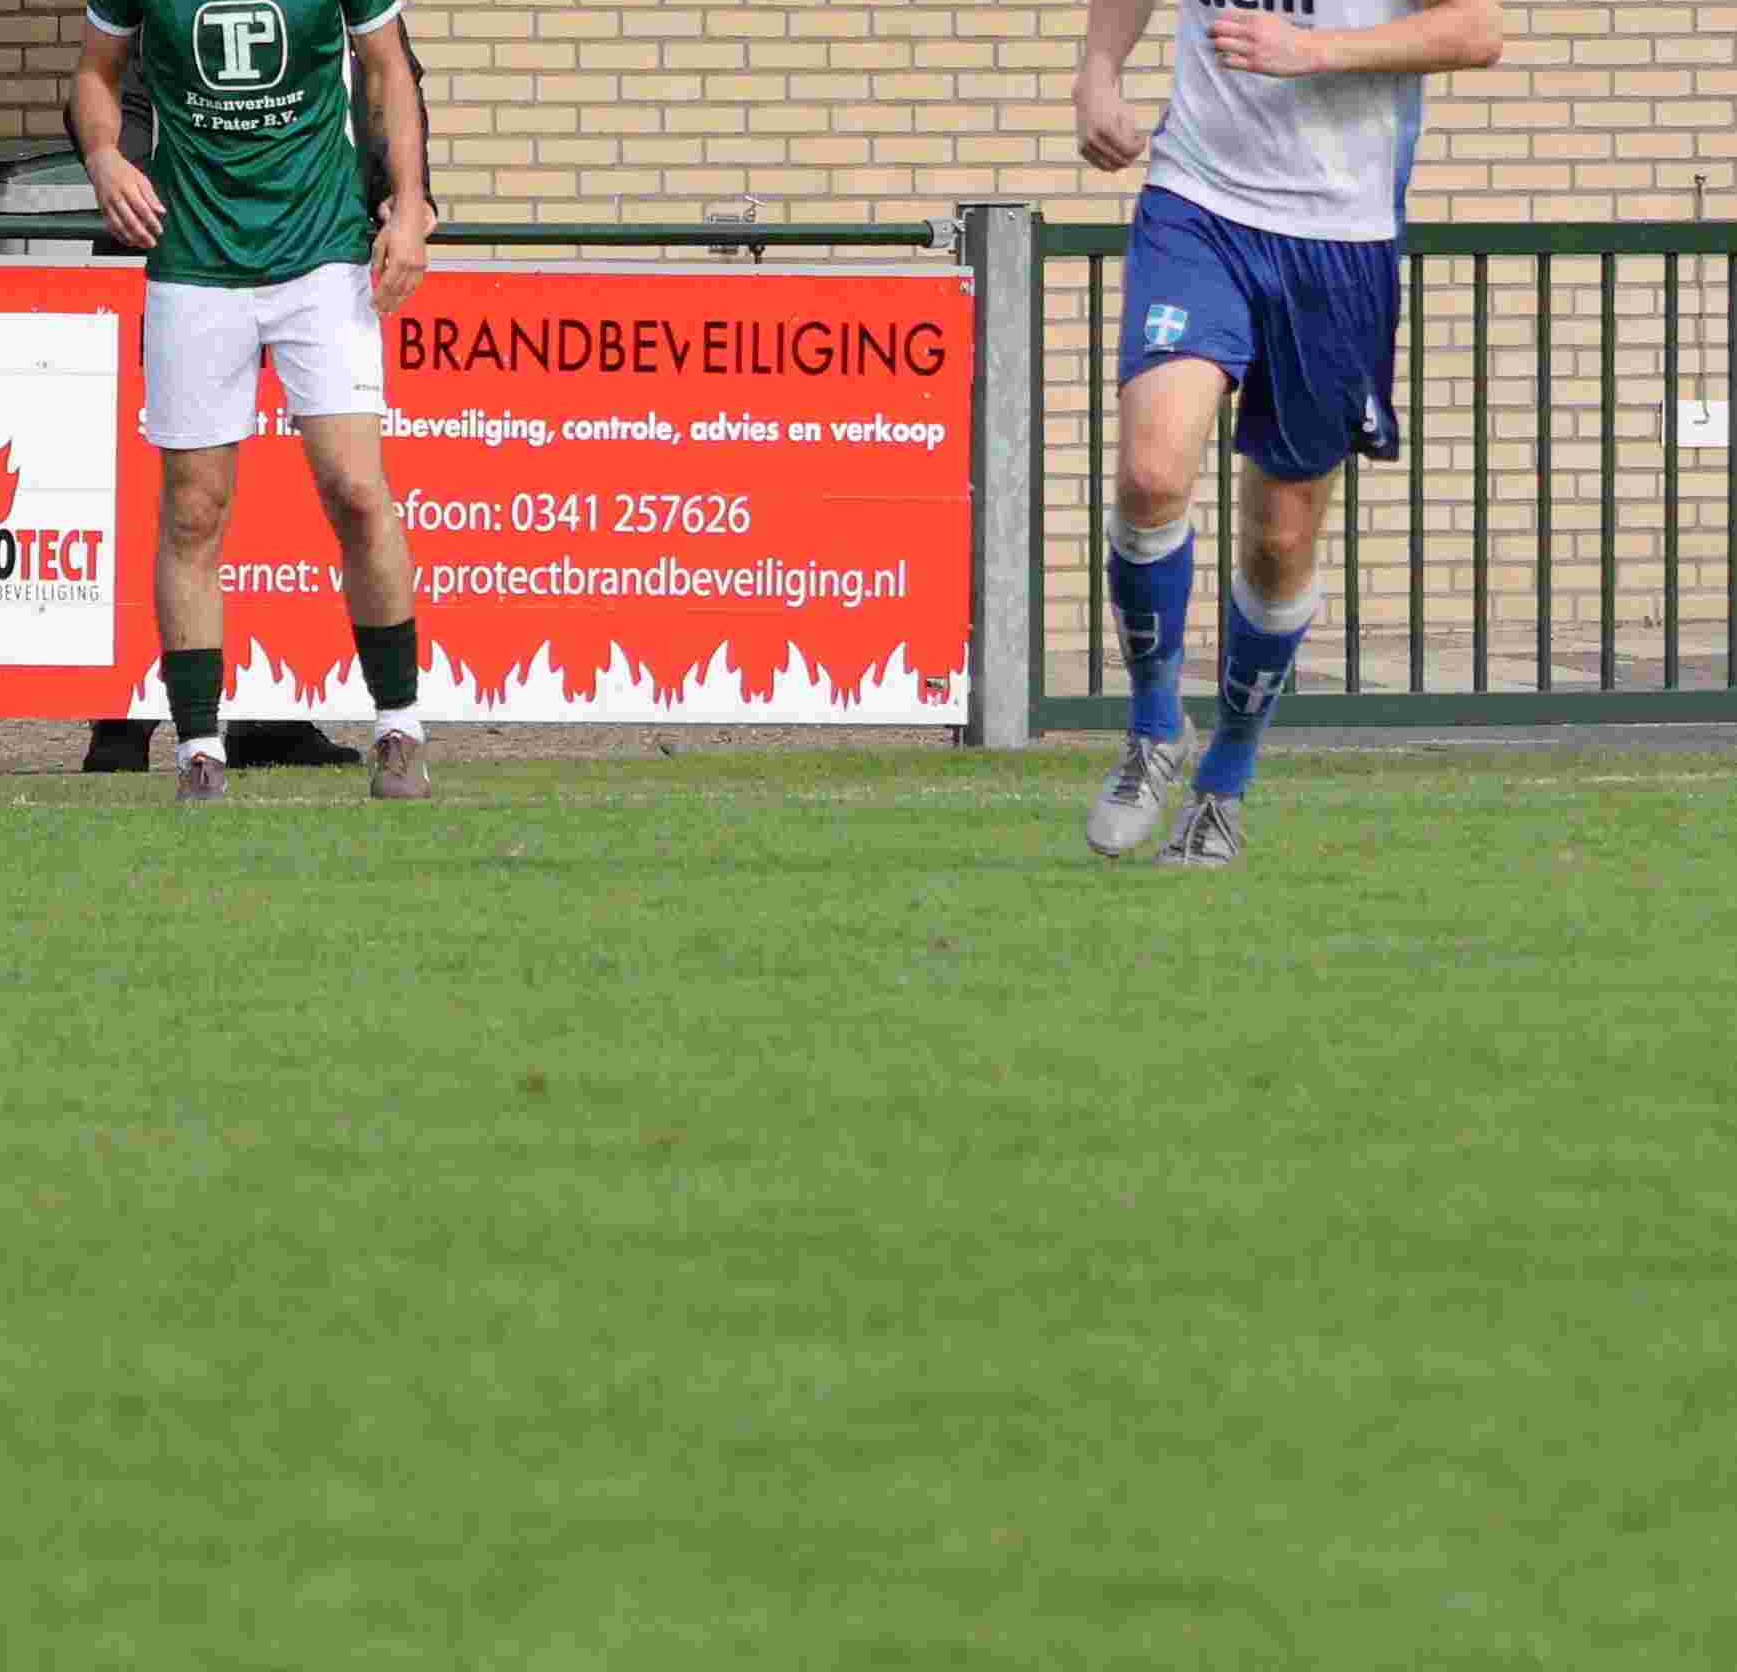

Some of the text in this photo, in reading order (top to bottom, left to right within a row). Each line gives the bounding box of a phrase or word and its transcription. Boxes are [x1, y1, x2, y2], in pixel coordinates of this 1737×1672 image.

[211, 114, 259, 132] Pater
[400, 317, 946, 377] BRANDBEVEILIGING
[382, 407, 945, 450] dbeveiliging, controle, advies en verkoop
[393, 488, 751, 533] foon: 0341 257626
[217, 557, 907, 608] ernet: .protectbrandbeveiliging.nl
